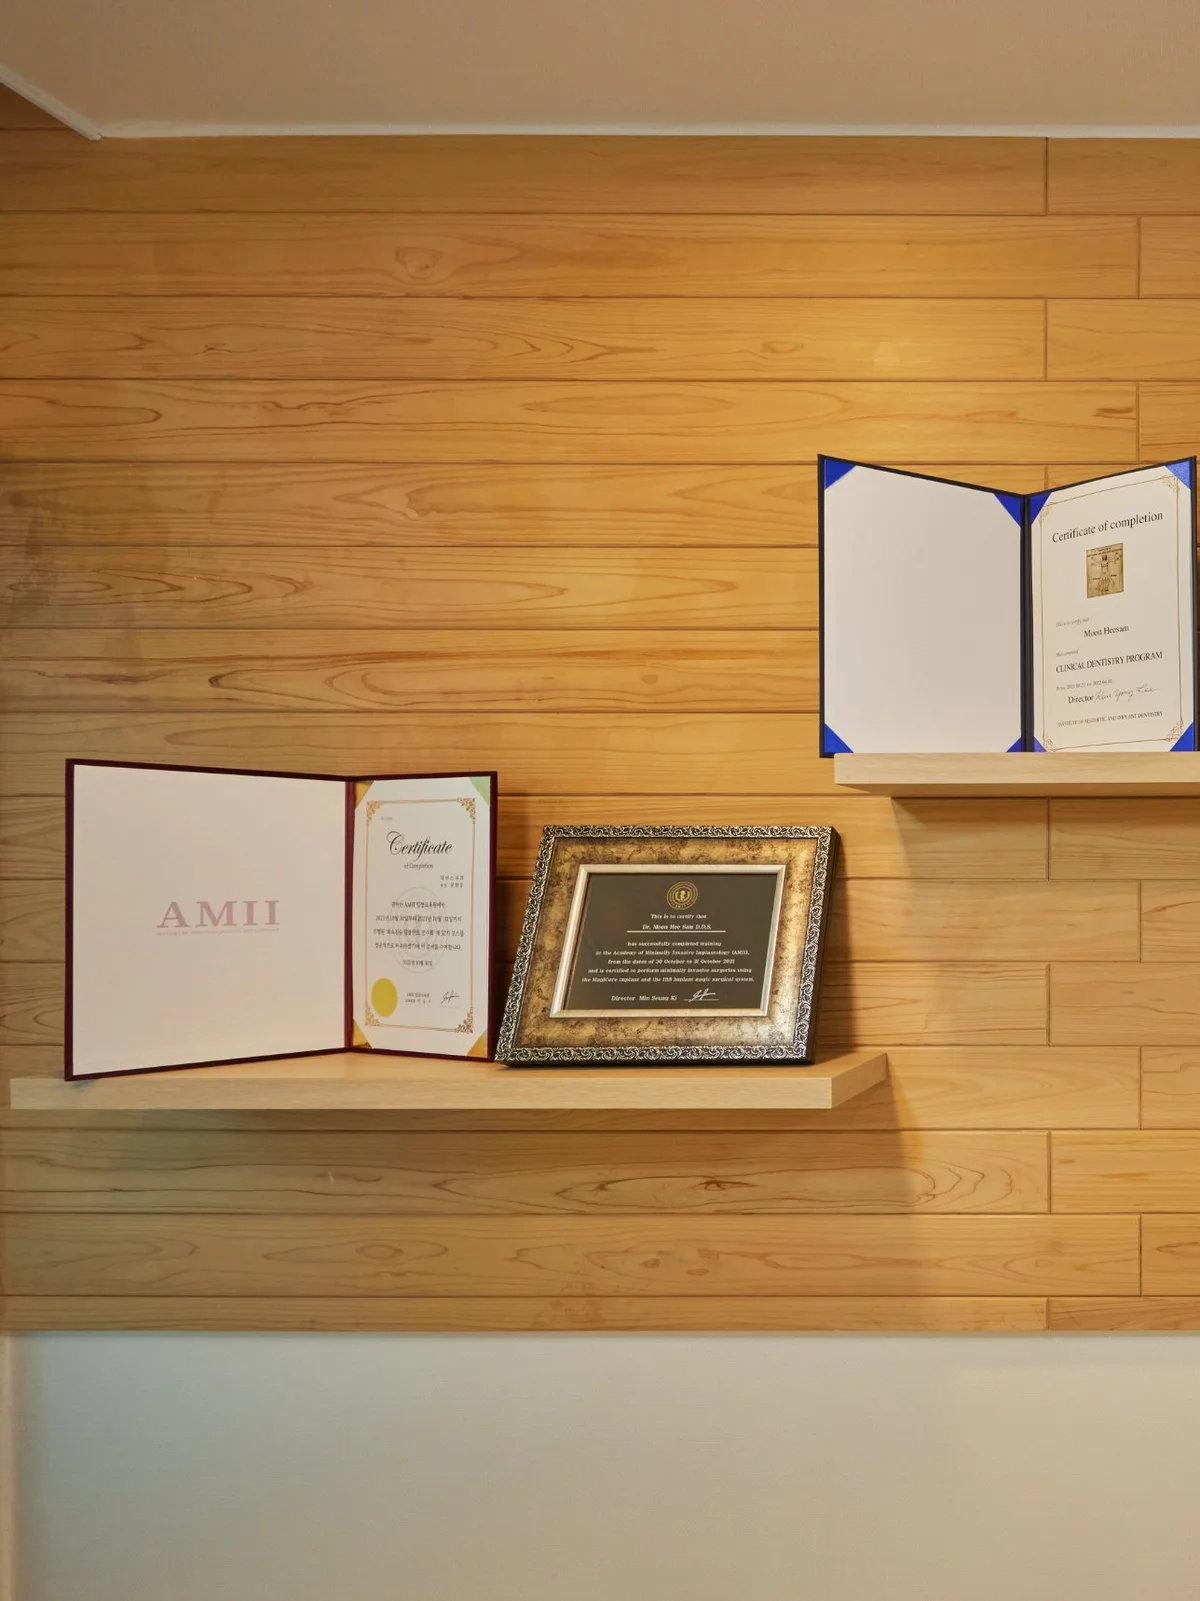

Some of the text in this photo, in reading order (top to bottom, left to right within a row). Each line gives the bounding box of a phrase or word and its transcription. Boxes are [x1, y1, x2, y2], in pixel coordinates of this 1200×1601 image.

[1052, 511, 1163, 543] Certificate of completion
[1056, 651, 1163, 673] CLINICAL DENTISTRY PROGRAM
[1068, 695, 1095, 704] Director
[386, 831, 453, 862] Certificate
[156, 900, 281, 928] AMII
